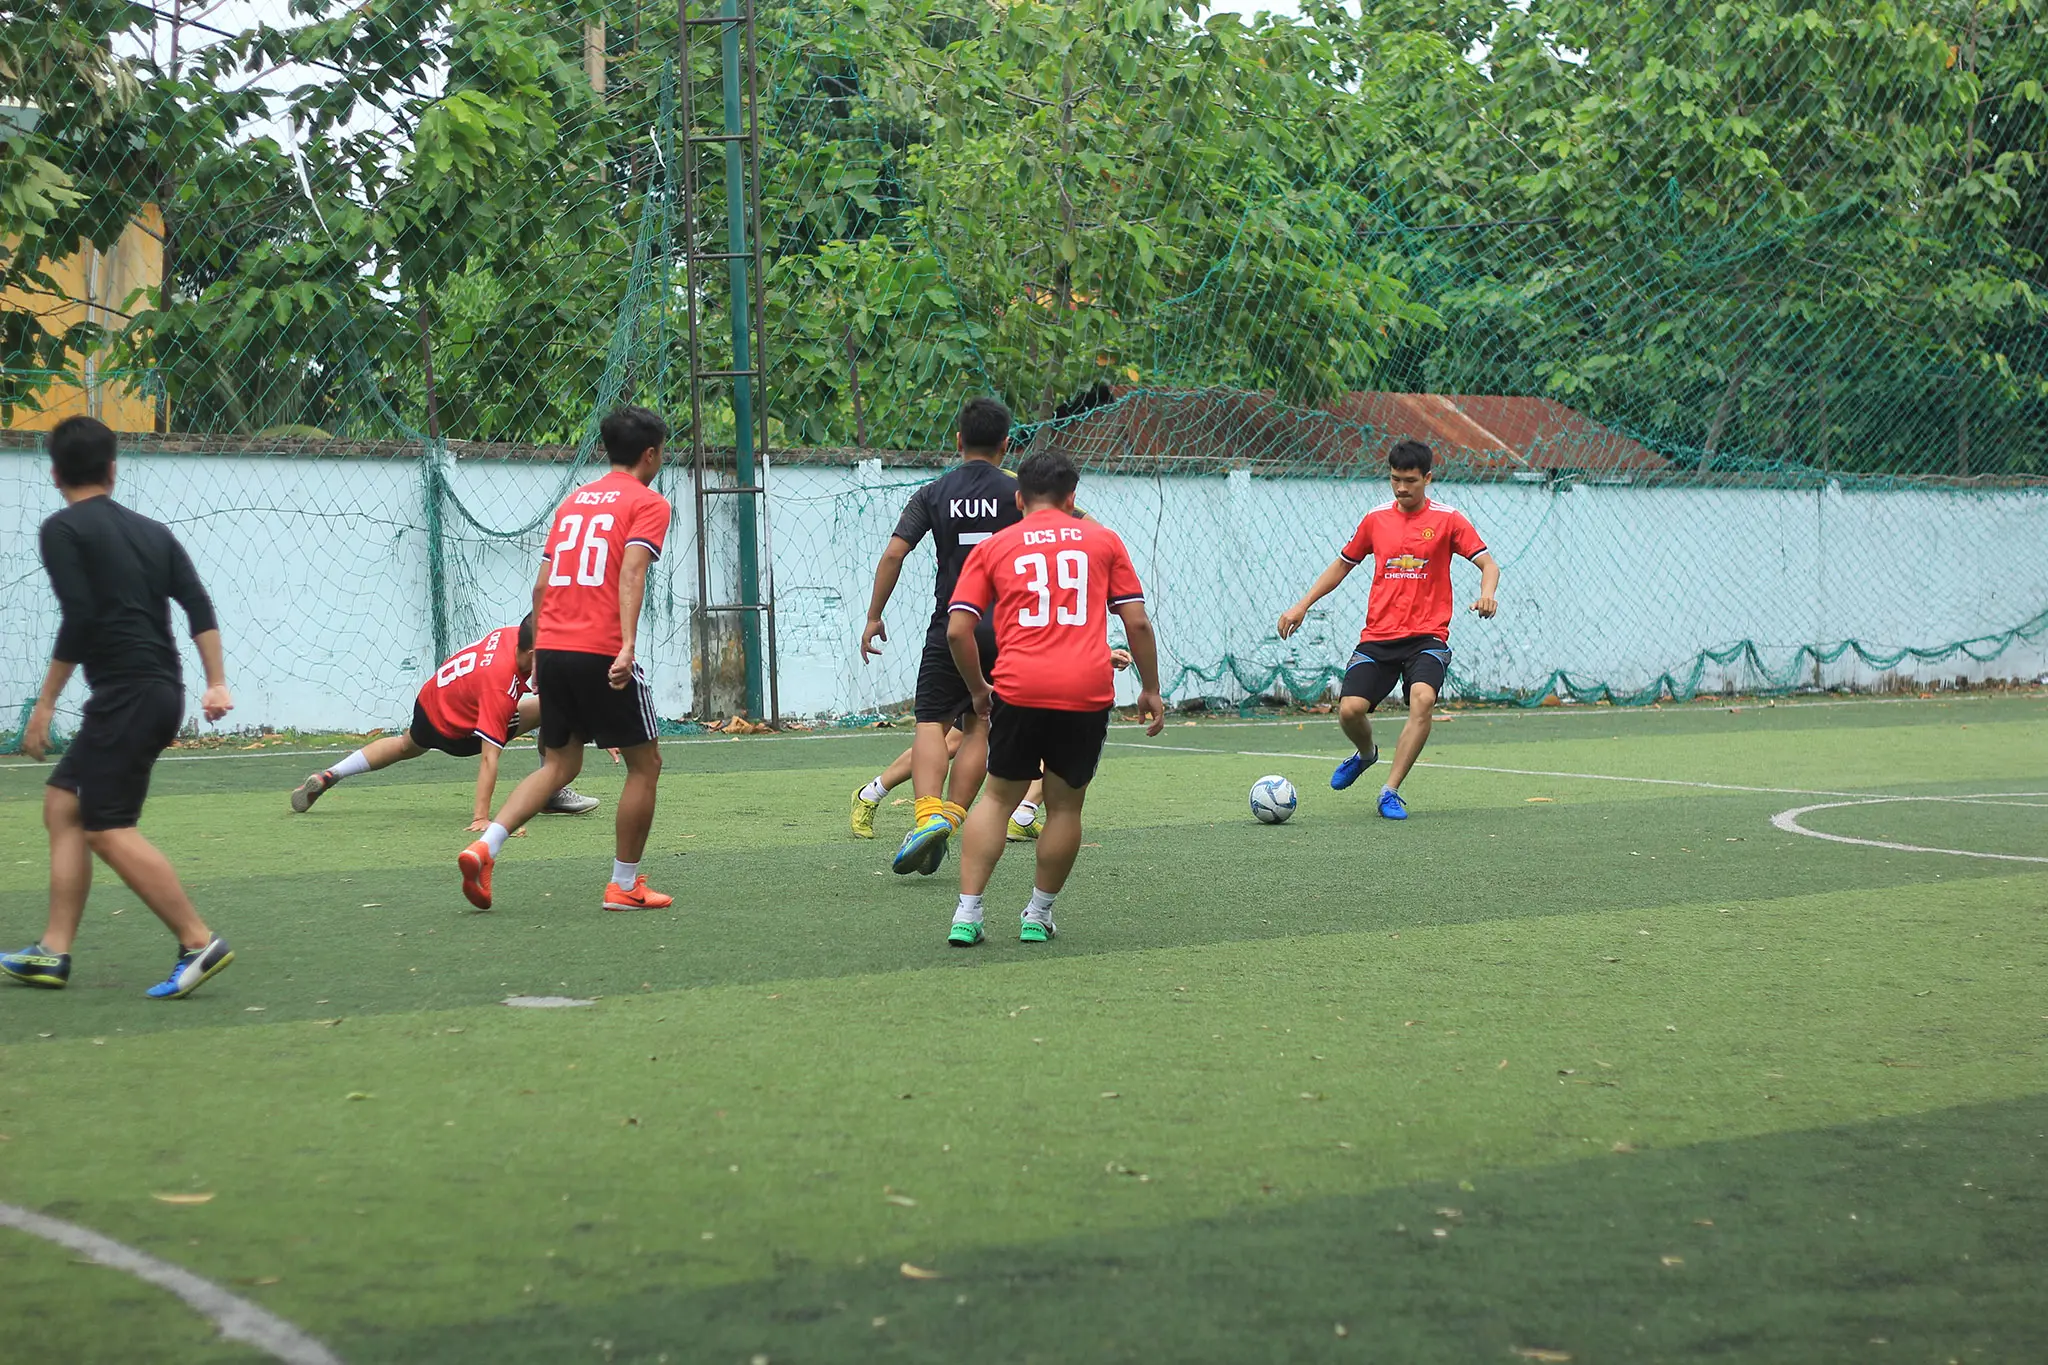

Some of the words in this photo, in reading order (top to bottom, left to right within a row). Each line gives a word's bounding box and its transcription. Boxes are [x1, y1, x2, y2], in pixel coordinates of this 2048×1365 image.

[600, 491, 621, 504] FC
[949, 498, 998, 518] KUN
[1060, 527, 1083, 541] FC
[548, 513, 615, 587] 26
[1014, 550, 1088, 627] 39
[479, 653, 494, 667] FC
